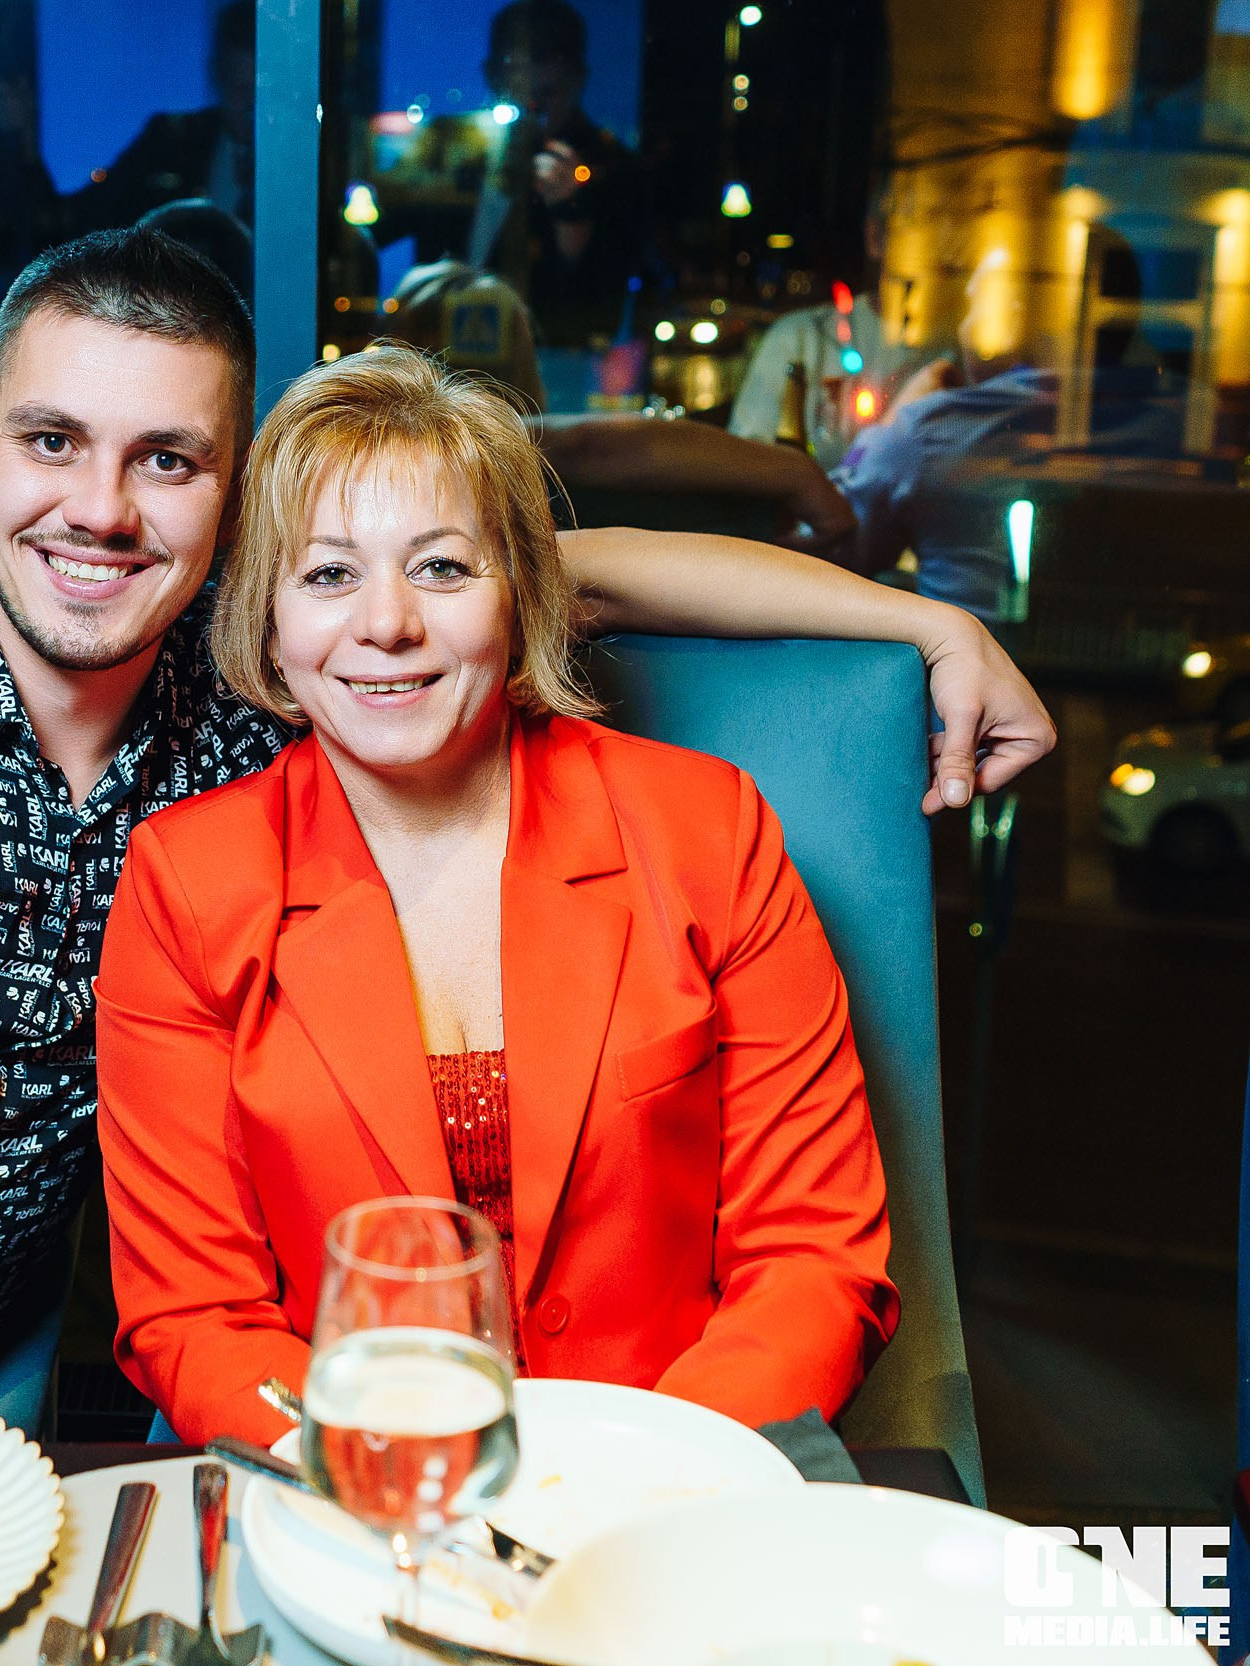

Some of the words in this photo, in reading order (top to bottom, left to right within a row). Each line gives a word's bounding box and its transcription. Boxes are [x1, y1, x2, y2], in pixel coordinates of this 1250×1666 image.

[226, 706, 255, 729] KARL
[230, 735, 254, 758] KARL
[89, 776, 116, 803] KARL
[174, 755, 188, 797] KARL
[26, 794, 42, 839] KARL
[1, 841, 11, 873] KARL
[15, 877, 38, 895] KARL
[86, 859, 94, 890] KARL
[48, 882, 64, 911] KARL
[17, 912, 32, 957] KARL
[1, 960, 53, 982] KARL
[19, 989, 37, 1019] KARL
[22, 1084, 53, 1096] KARL
